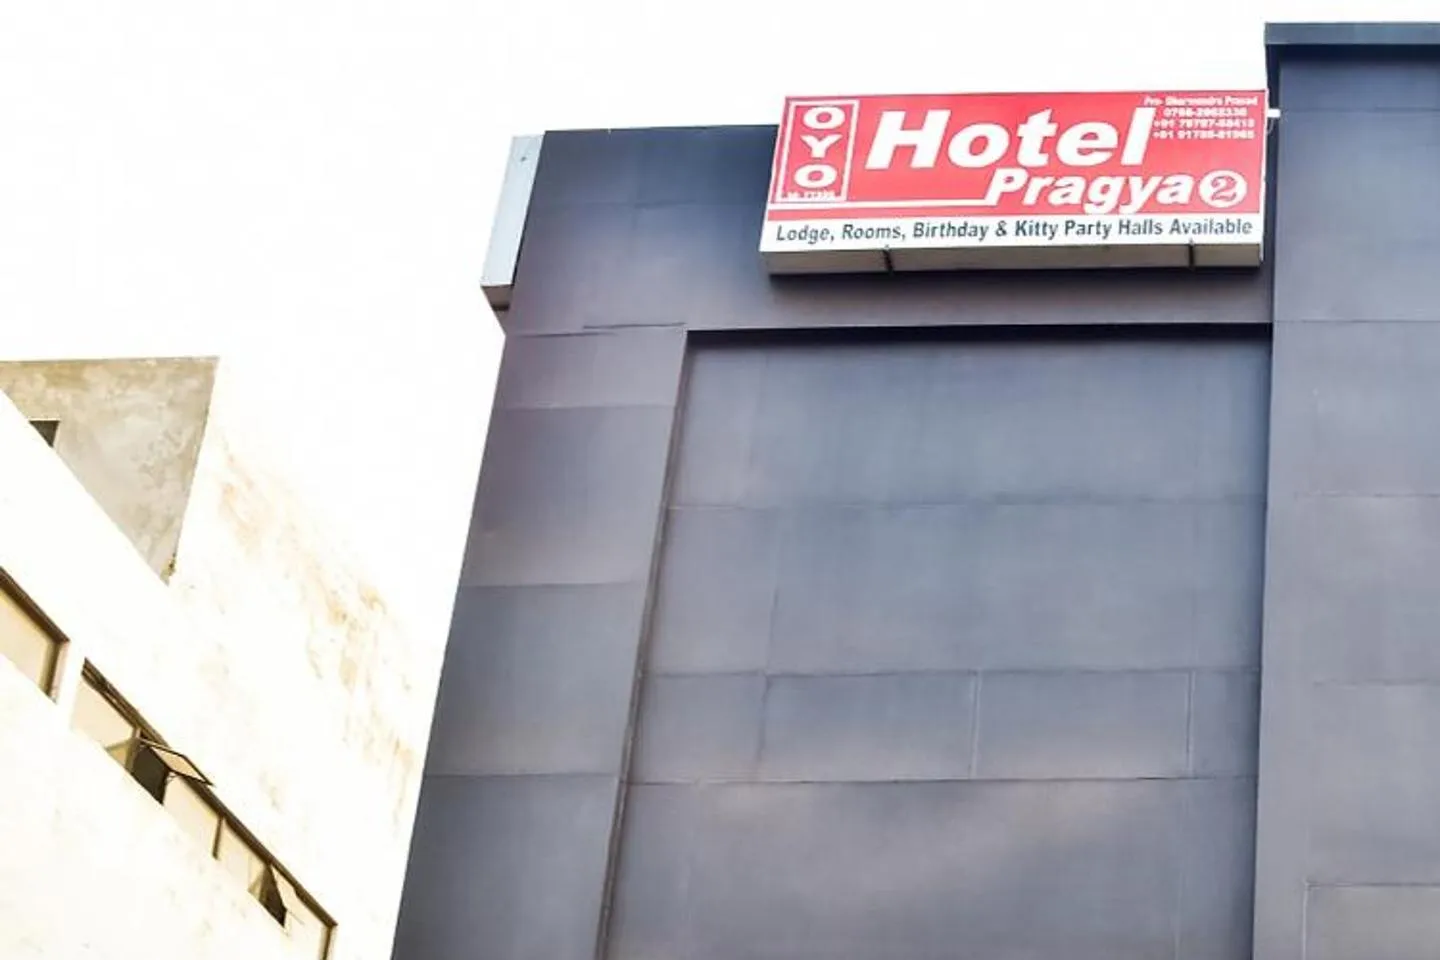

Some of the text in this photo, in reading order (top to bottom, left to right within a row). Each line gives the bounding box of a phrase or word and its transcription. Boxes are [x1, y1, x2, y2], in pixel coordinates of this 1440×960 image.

[794, 106, 846, 189] OYO
[865, 106, 1155, 170] Hotel
[983, 167, 1242, 214] Pragya 2
[776, 218, 1254, 245] Lodge, Rooms, Birthday & Kitty Party Halls Available
